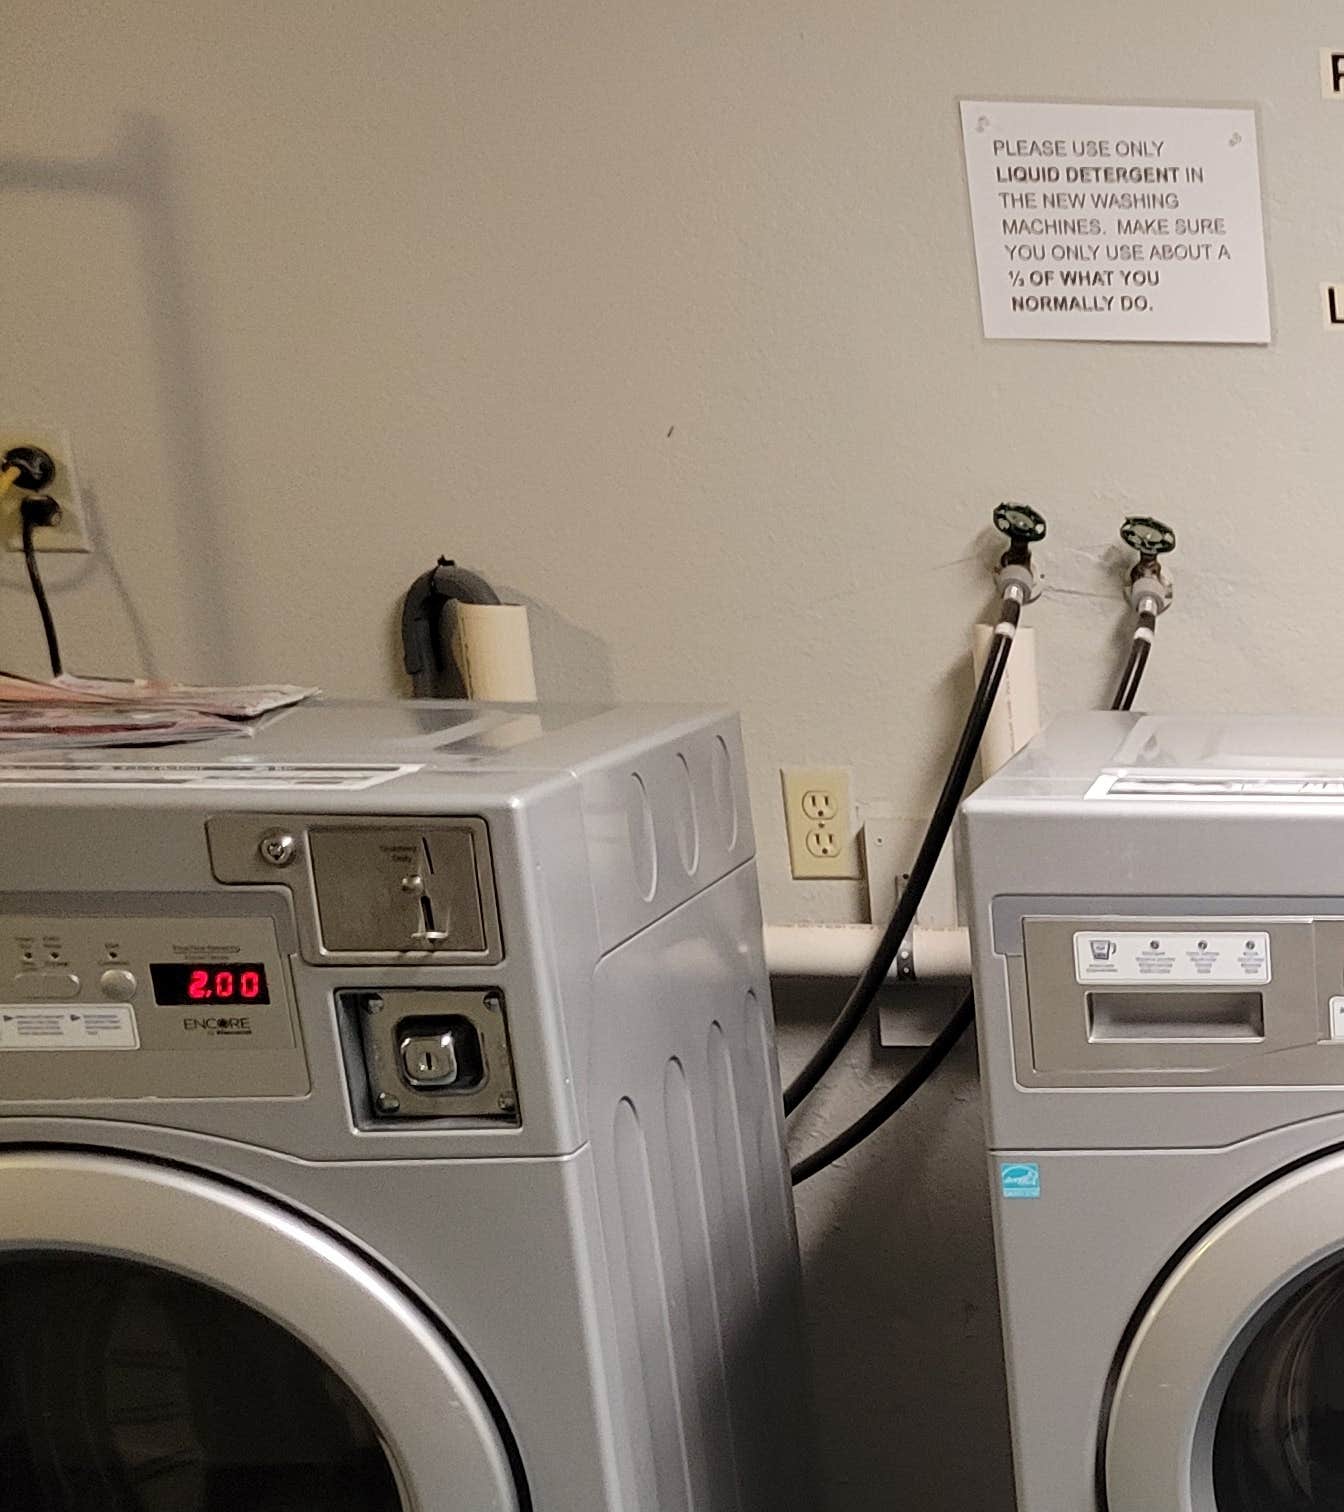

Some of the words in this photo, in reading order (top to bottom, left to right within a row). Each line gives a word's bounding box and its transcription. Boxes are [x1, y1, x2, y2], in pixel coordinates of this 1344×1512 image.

[993, 139, 1066, 157] PLEASE
[1072, 140, 1110, 157] USE
[1115, 140, 1165, 157] ONLY
[996, 166, 1060, 183] LIQUID
[1065, 166, 1180, 183] DETERGENT
[1185, 167, 1204, 183] IN
[998, 192, 1037, 209] THE
[1043, 192, 1086, 209] NEW
[1090, 193, 1180, 209] WASHING
[1002, 218, 1107, 235] MACHINES.
[1117, 218, 1169, 235] MAKE
[1175, 218, 1227, 235] SURE
[1004, 244, 1046, 261] YOU
[1051, 244, 1100, 261] ONLY
[1106, 244, 1145, 261] USE
[1149, 244, 1212, 261] ABOUT
[1217, 244, 1232, 261] A
[1029, 270, 1055, 287] OF
[1060, 270, 1114, 287] WHAT
[1120, 270, 1160, 287] YOU
[1011, 295, 1115, 312] NORMALLY
[1120, 295, 1154, 312] DO.
[188, 970, 260, 999] 2.00
[183, 1017, 251, 1031] ENCORE
